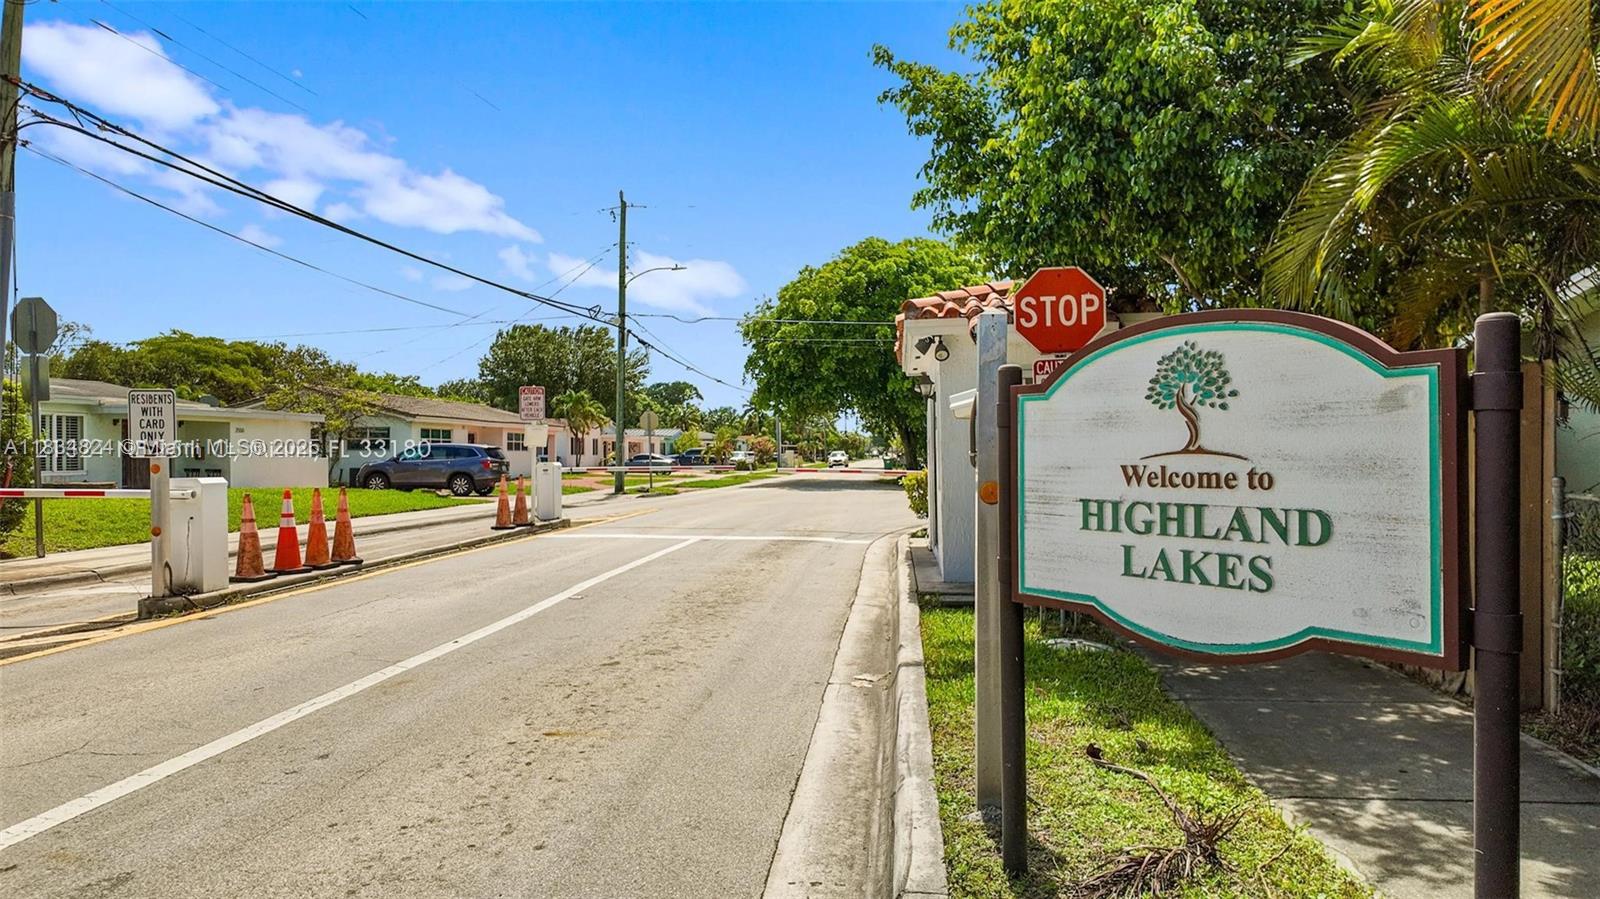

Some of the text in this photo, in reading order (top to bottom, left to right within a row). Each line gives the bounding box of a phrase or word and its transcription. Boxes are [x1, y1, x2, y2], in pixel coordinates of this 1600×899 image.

[1020, 294, 1100, 328] STOP
[131, 394, 172, 404] RESIDENTS
[141, 407, 163, 416] WITH
[140, 419, 165, 429] CARD
[141, 431, 164, 441] ONLY
[1120, 465, 1275, 491] Welcome to
[1079, 498, 1334, 547] HIGHLAND
[1120, 544, 1275, 593] LAKES
